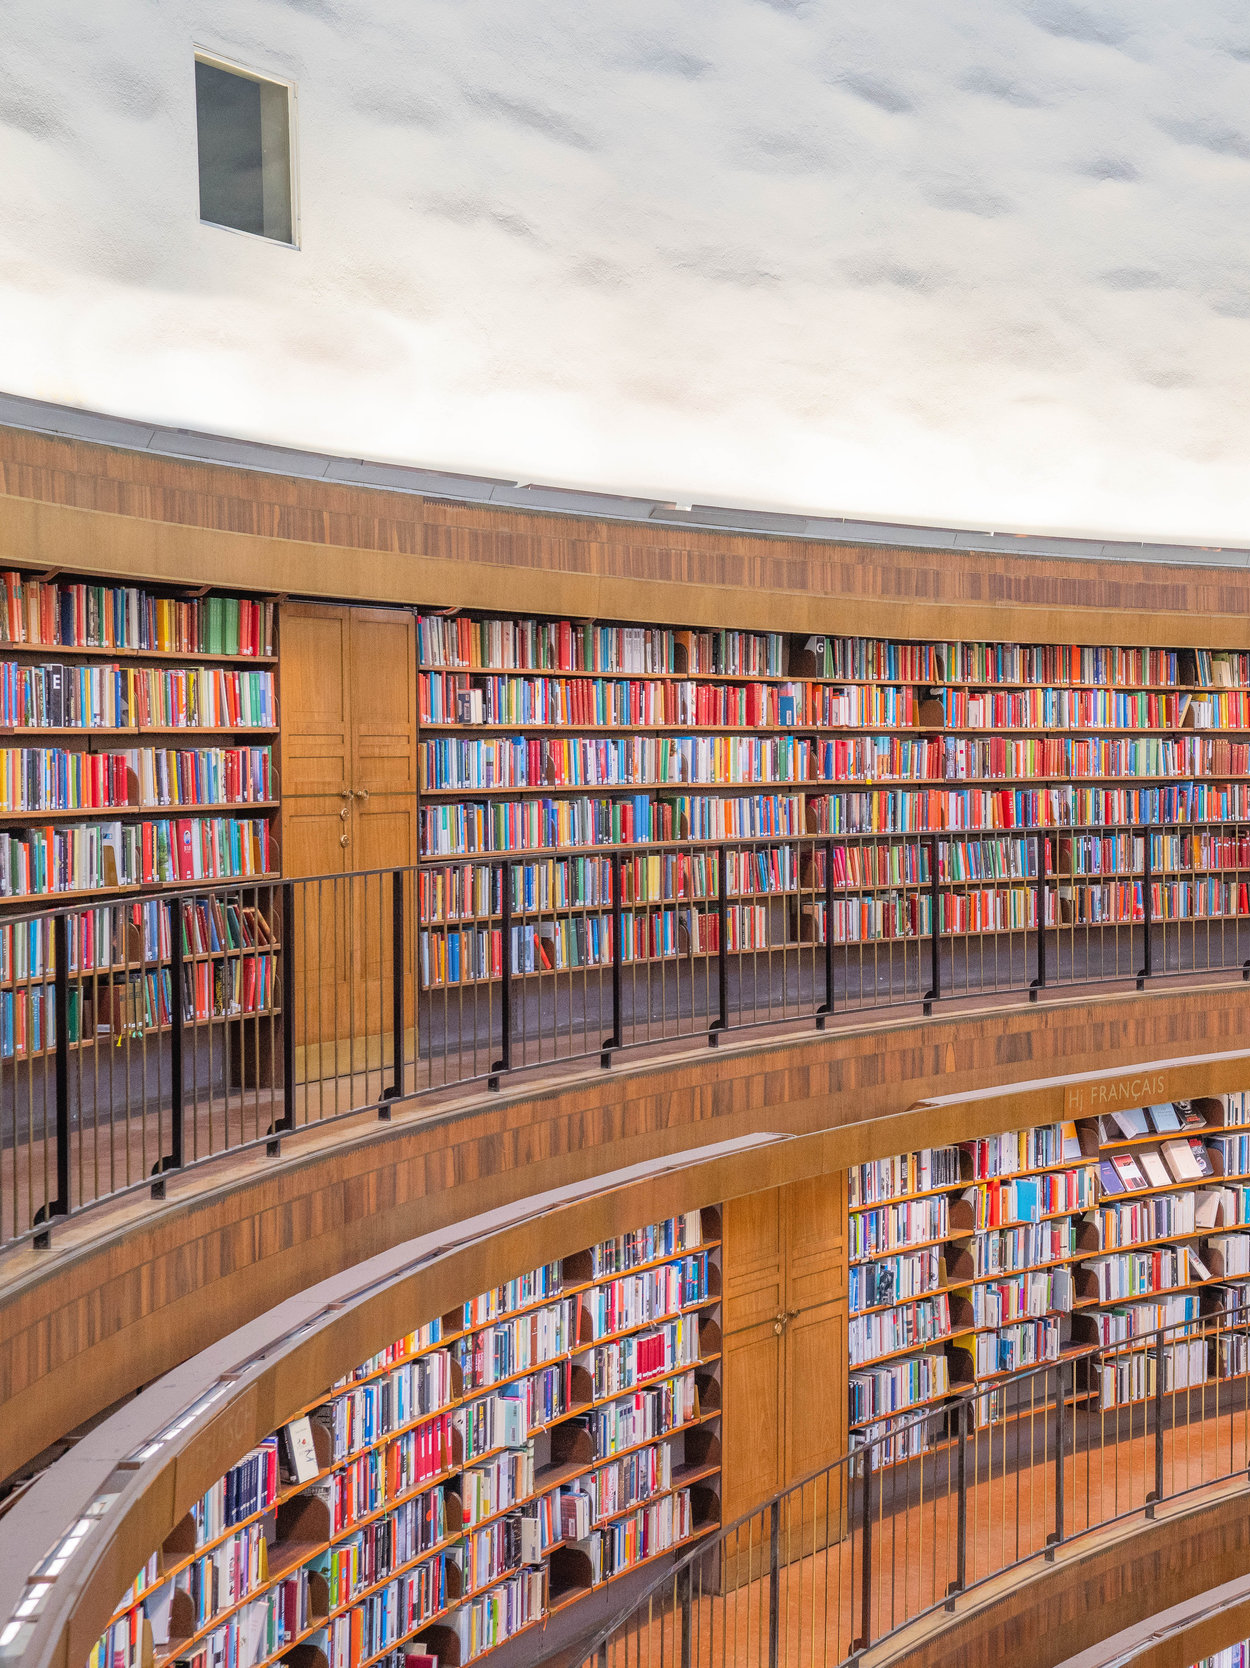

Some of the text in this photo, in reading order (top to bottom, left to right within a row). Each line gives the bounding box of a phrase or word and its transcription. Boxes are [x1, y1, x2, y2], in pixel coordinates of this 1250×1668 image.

[816, 643, 825, 653] G
[52, 675, 61, 689] E
[1068, 1076, 1165, 1112] Hj FRANÇAIS
